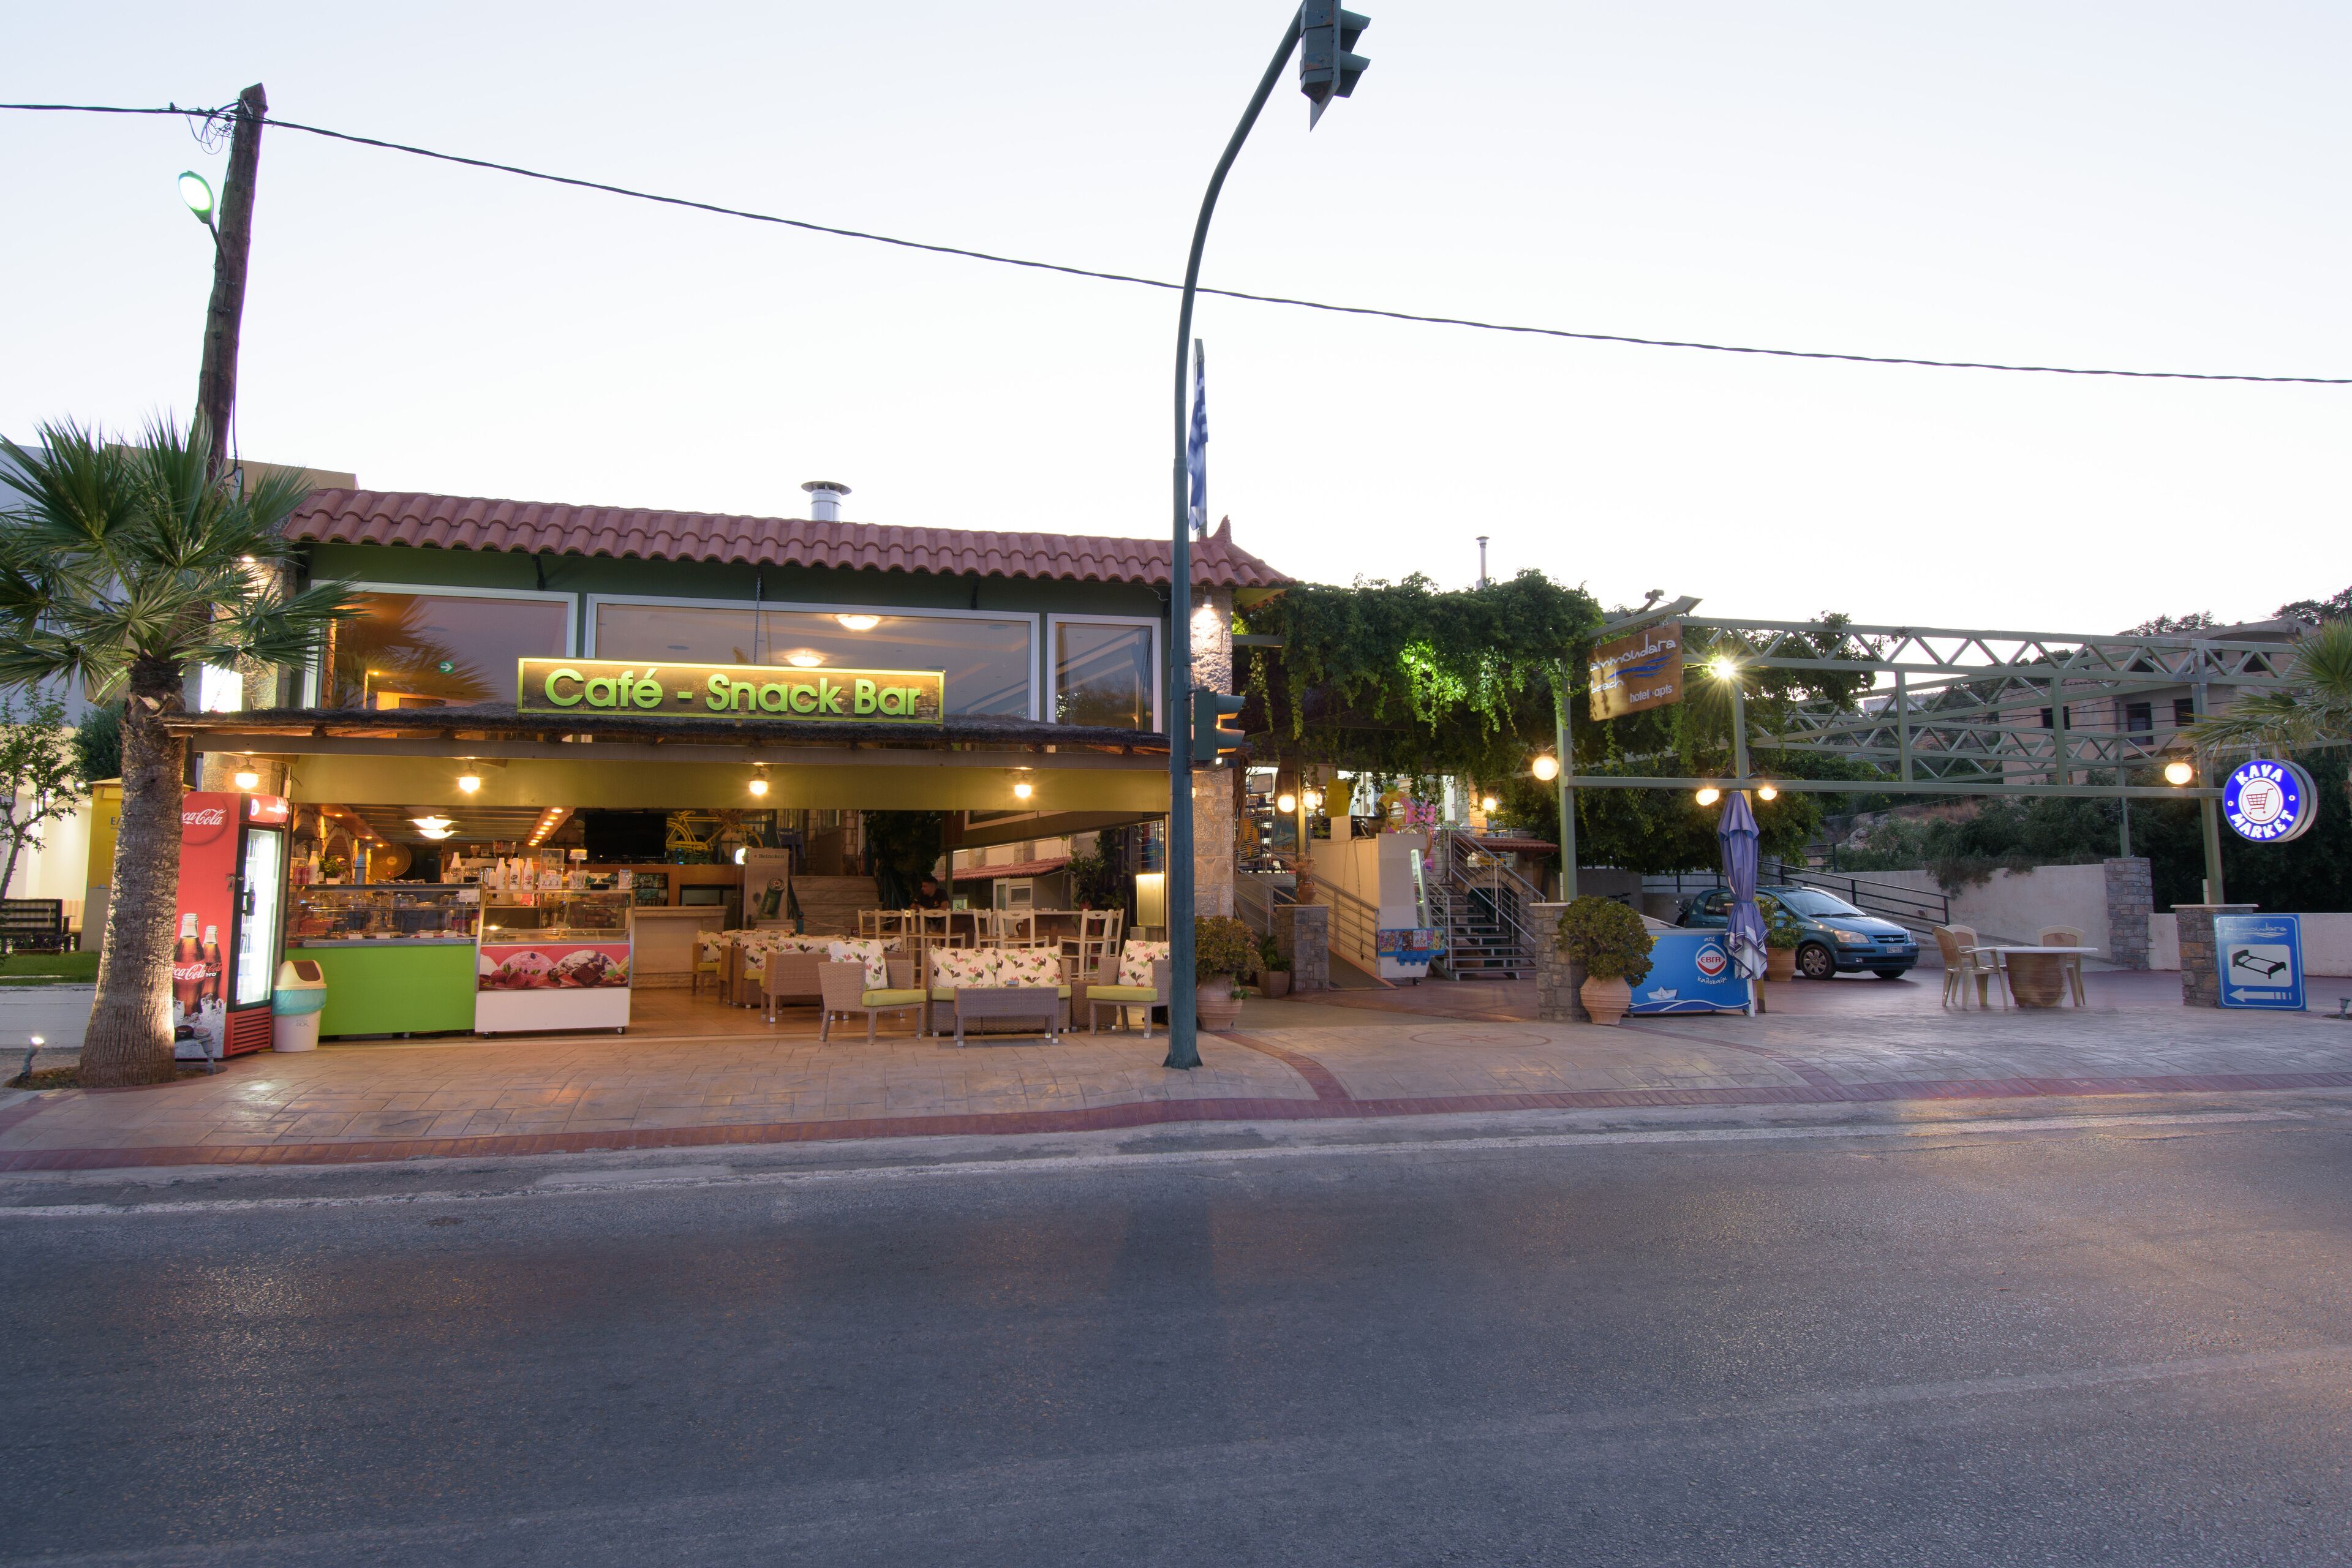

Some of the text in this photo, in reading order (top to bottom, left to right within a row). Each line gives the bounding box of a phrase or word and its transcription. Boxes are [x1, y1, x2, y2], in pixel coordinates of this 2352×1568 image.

[545, 668, 663, 708] Café
[706, 674, 843, 714] Snack
[854, 679, 921, 715] Bar
[1591, 669, 1624, 694] beach
[1630, 684, 1673, 703] hotel apts
[2234, 764, 2283, 786] KAVA
[183, 809, 227, 825] ca-Cola
[2230, 809, 2294, 839] MARKET
